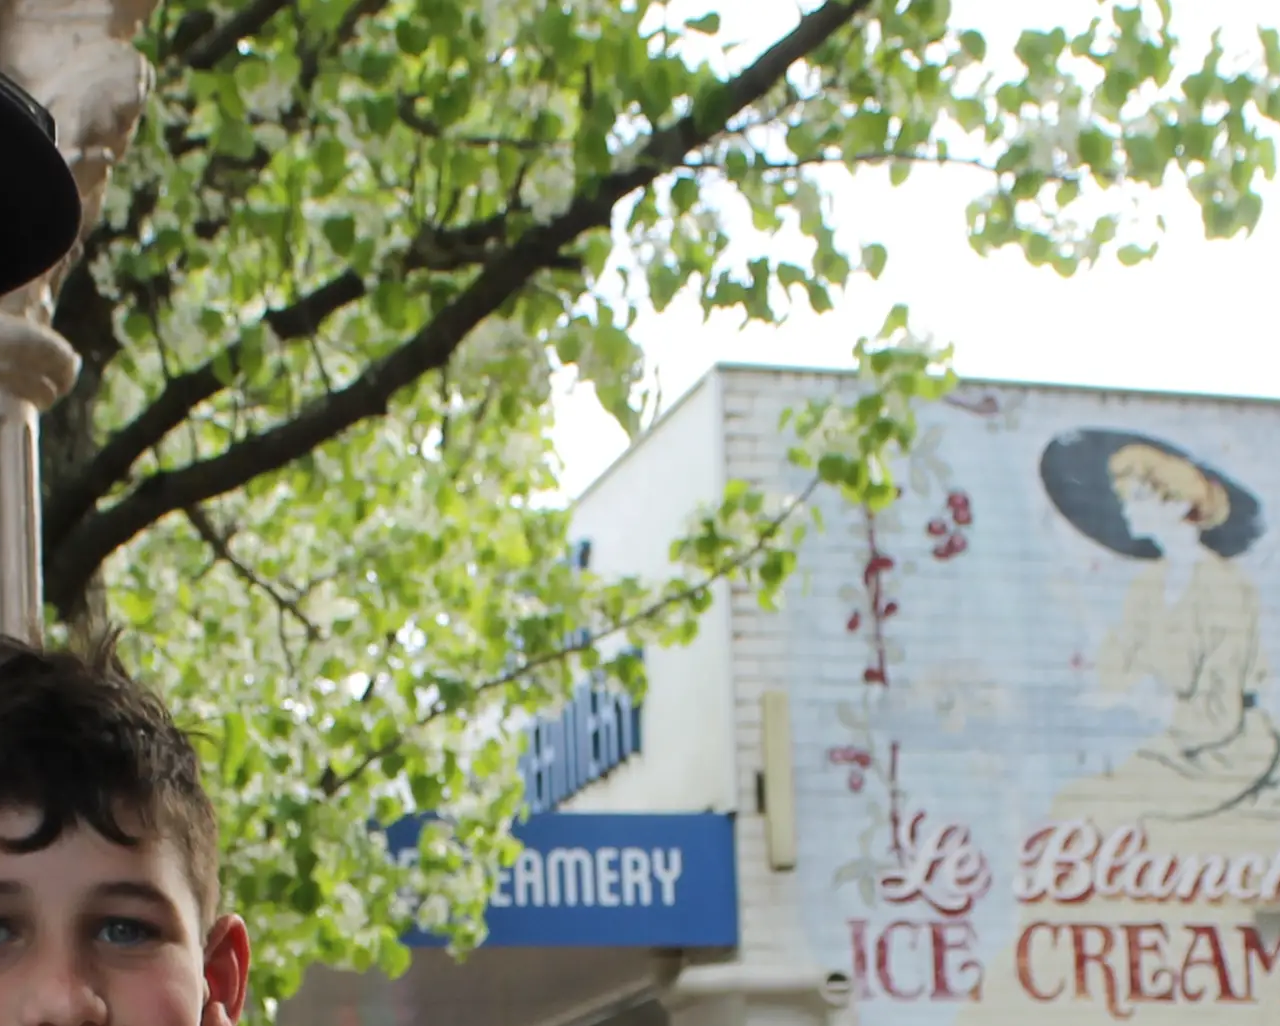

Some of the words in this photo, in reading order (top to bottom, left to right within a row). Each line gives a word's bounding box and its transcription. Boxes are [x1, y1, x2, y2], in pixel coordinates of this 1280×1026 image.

[489, 846, 683, 908] EAMERY
[880, 812, 992, 917] Le
[846, 918, 984, 1003] ICE
